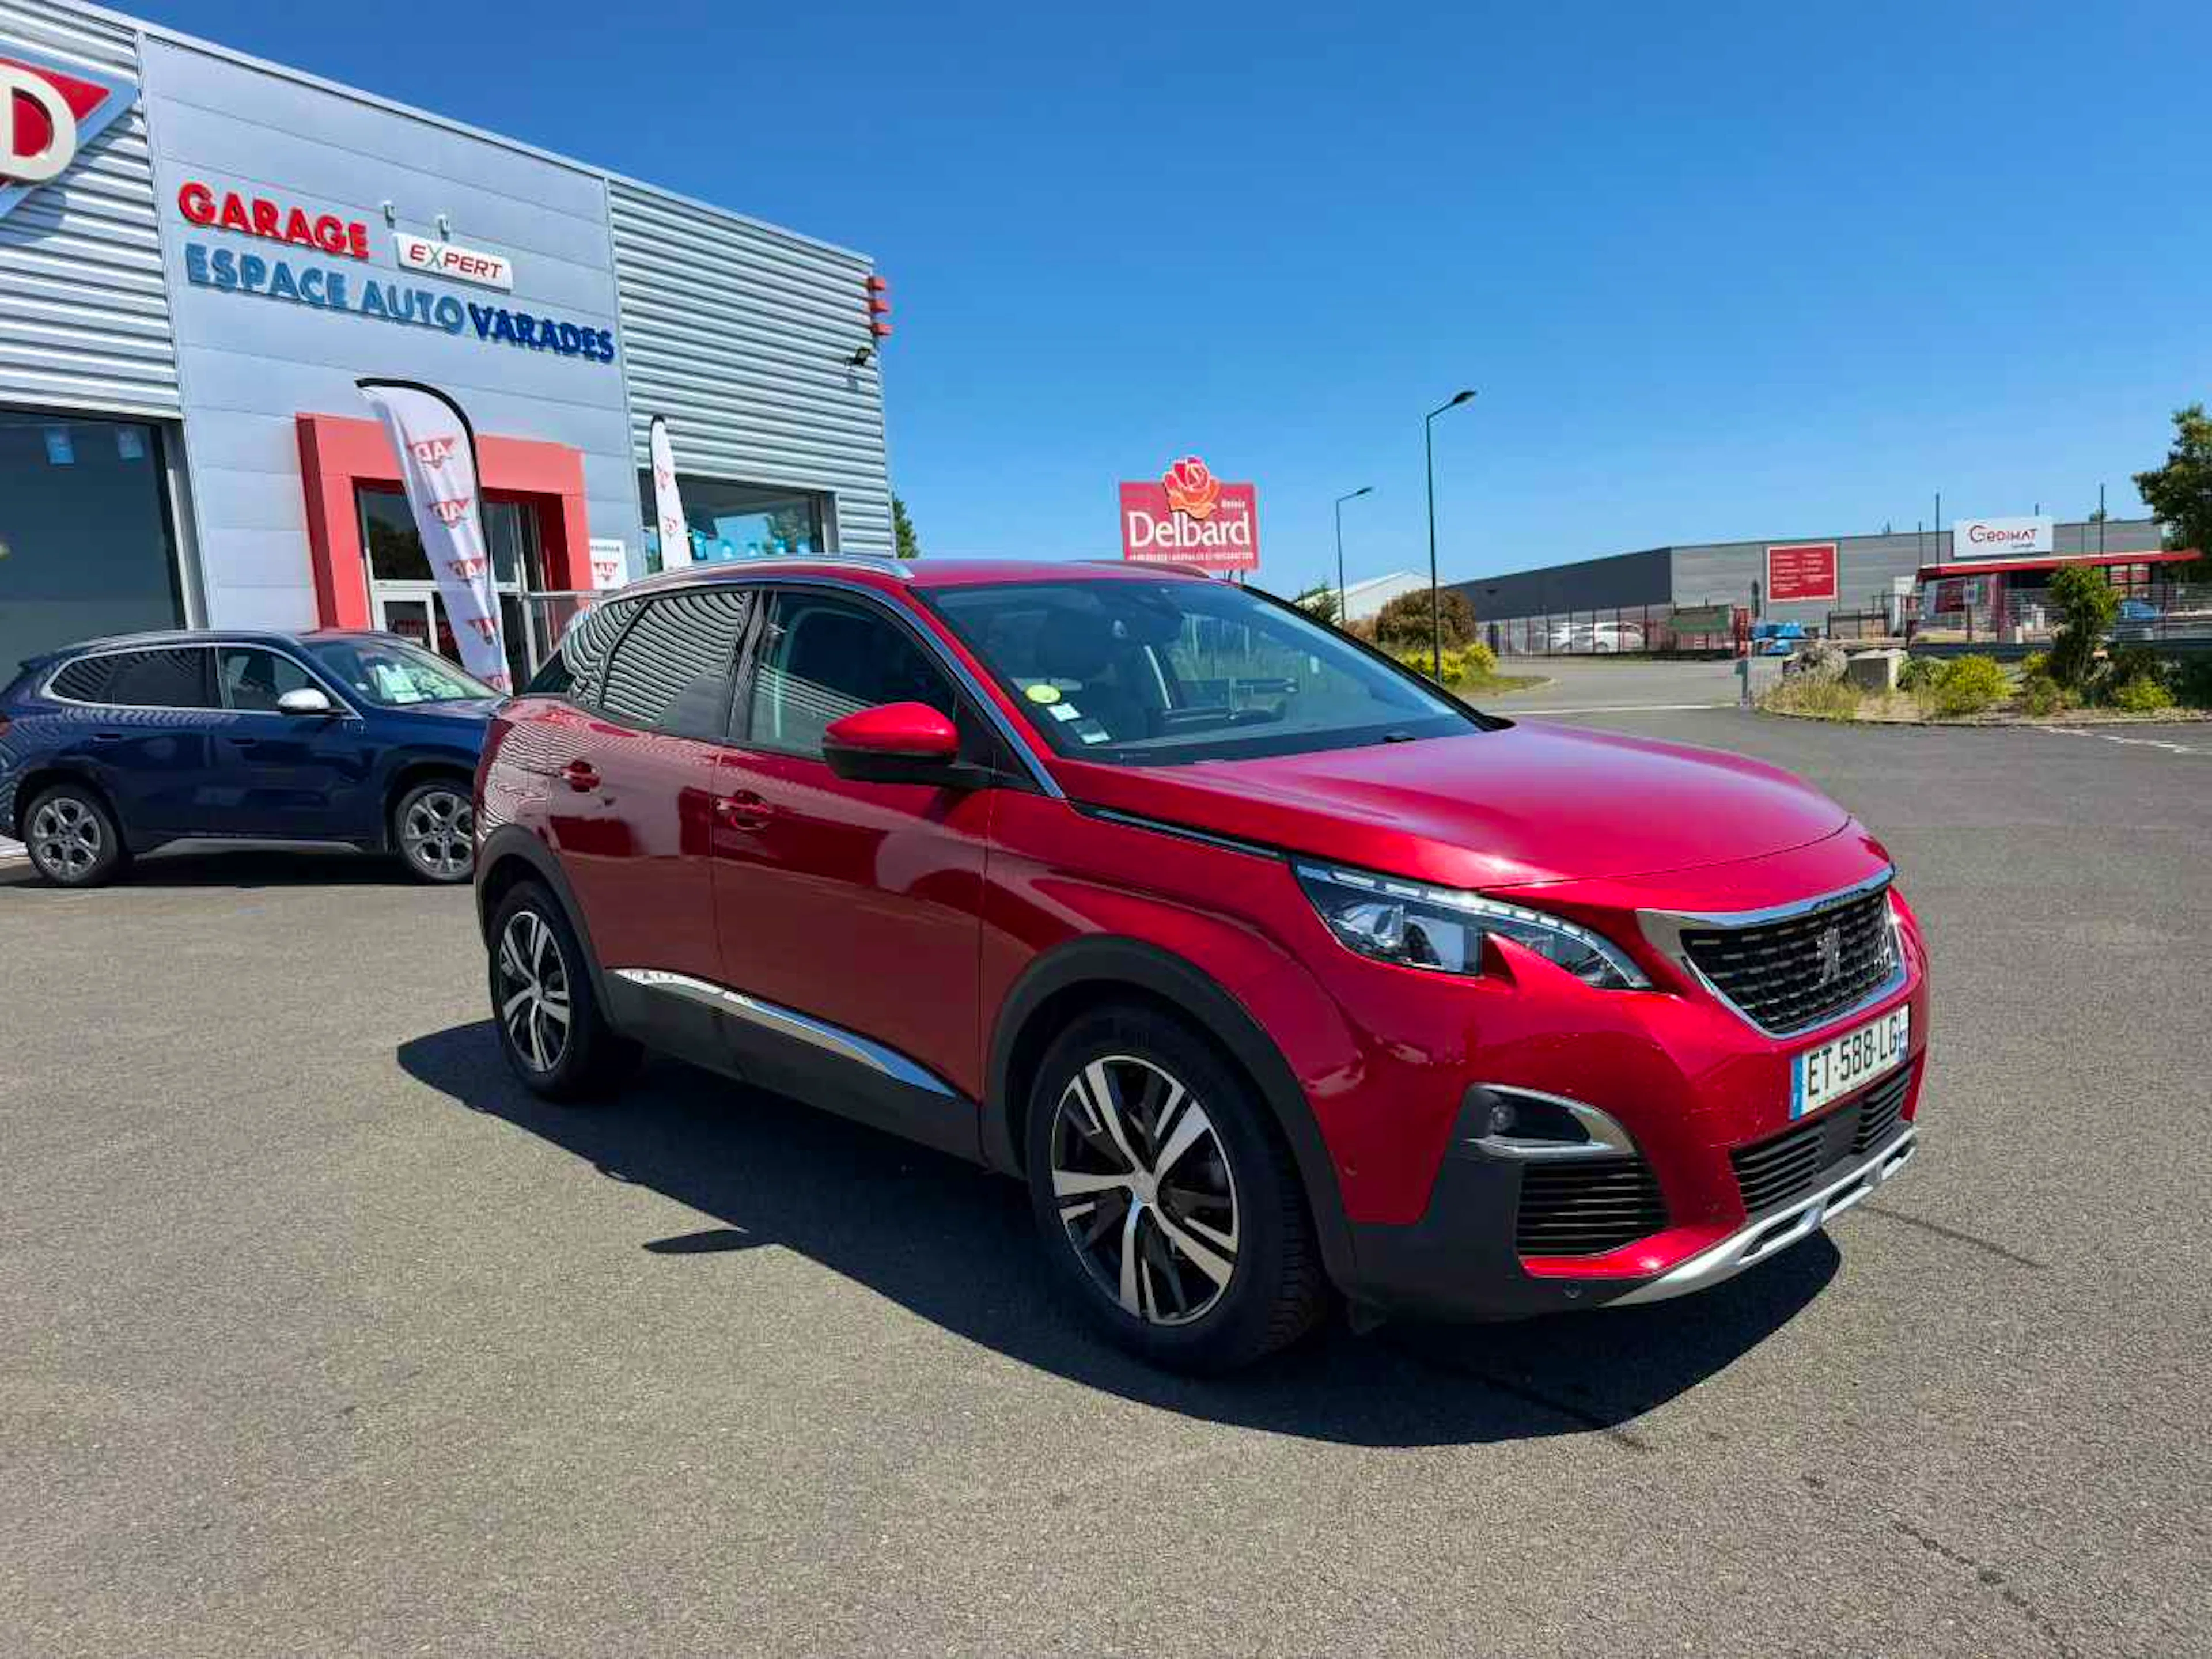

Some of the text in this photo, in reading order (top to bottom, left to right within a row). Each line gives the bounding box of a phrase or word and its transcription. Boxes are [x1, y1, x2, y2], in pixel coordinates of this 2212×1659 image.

[178, 181, 369, 262] GARAGE
[410, 243, 503, 279] EXPERT
[185, 242, 615, 364] ESPACE AUTO VARADES
[1128, 510, 1251, 547] Delbard
